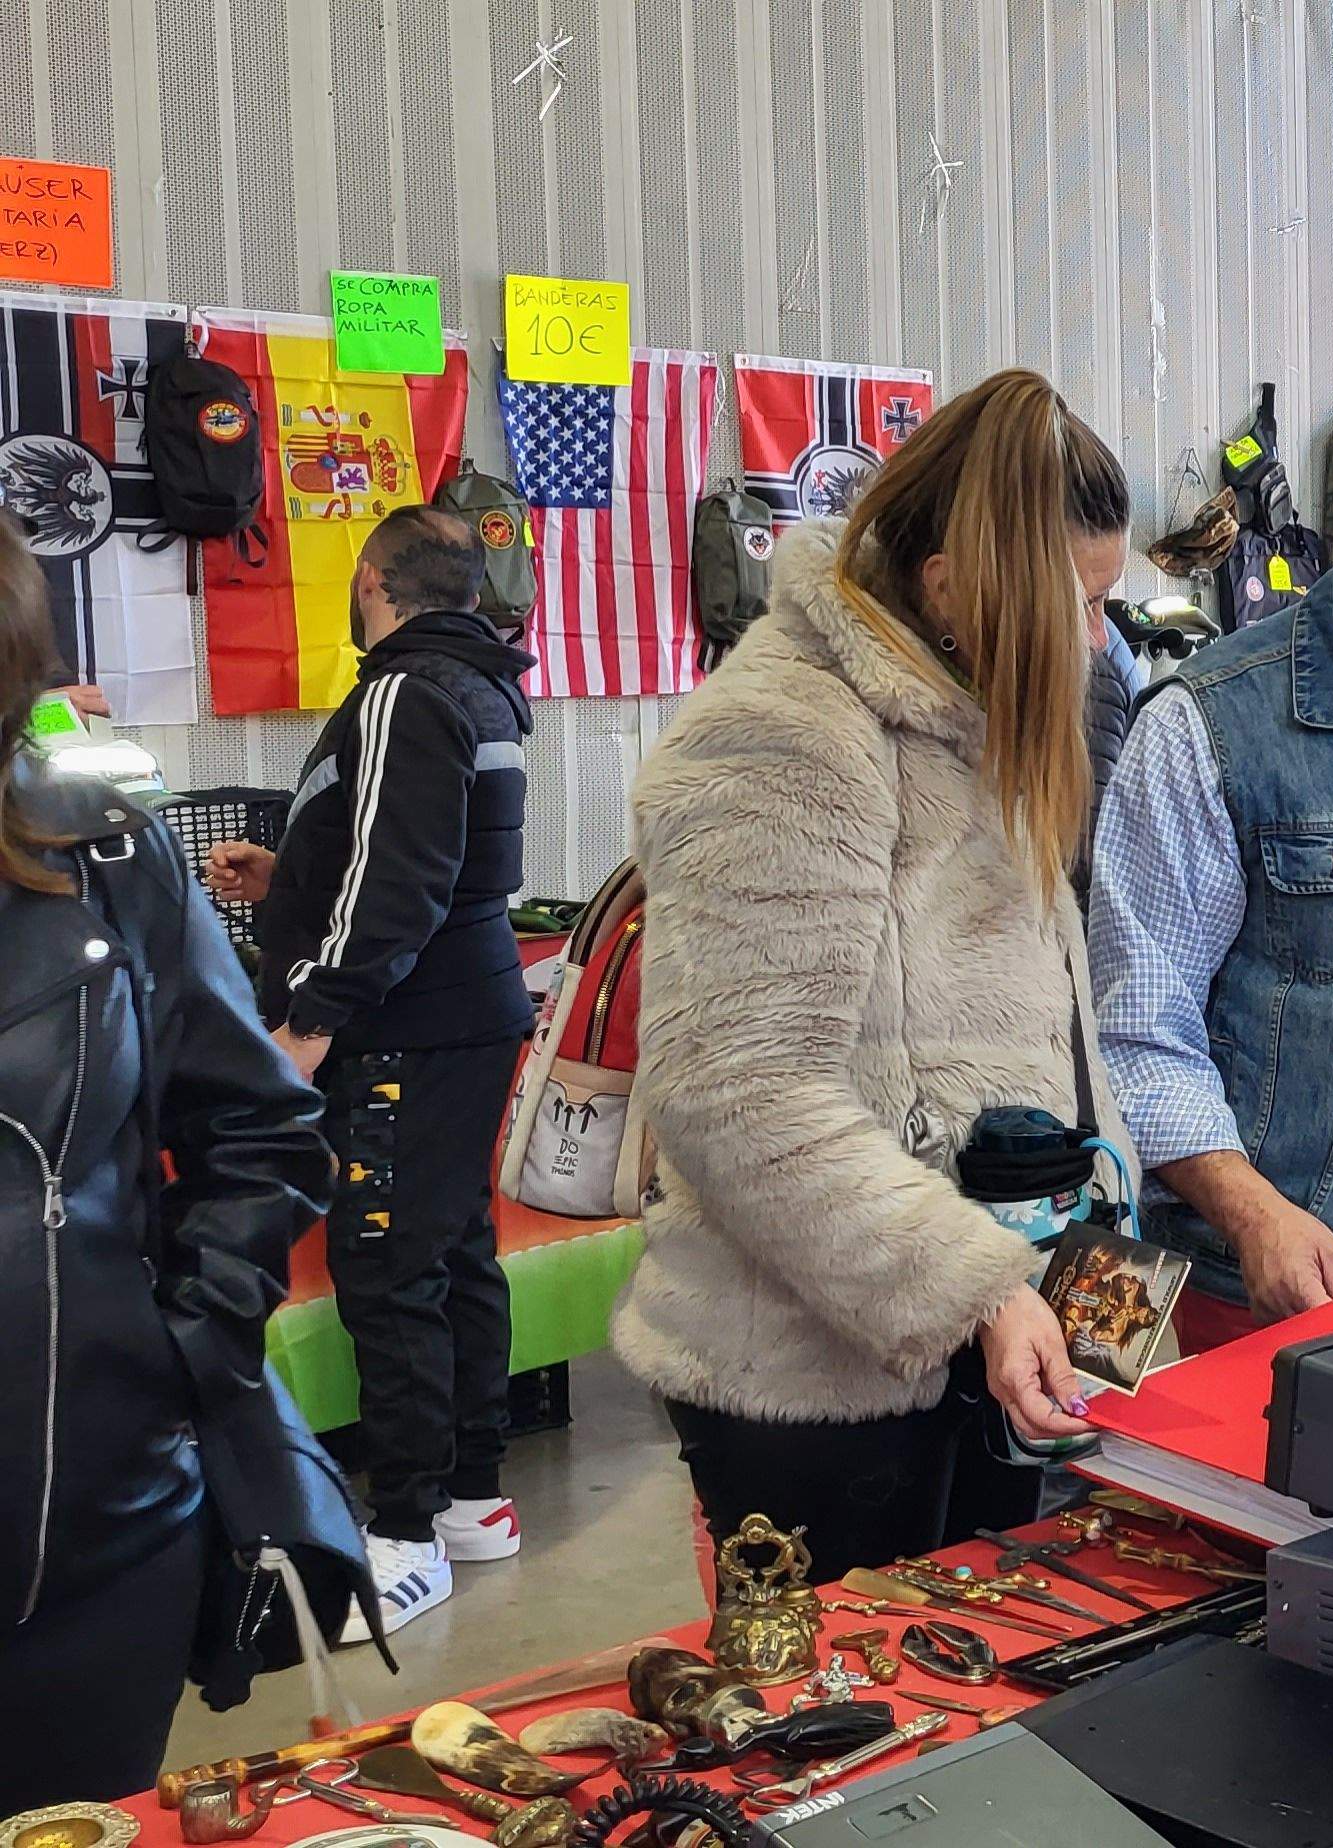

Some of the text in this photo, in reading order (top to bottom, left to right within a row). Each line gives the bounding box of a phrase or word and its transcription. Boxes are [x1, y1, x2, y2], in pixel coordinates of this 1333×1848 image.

[360, 277, 433, 296] COMPRA
[513, 283, 617, 310] BANDERAS
[337, 299, 387, 315] ROPA
[526, 313, 604, 355] 10€
[560, 1138, 579, 1154] DO
[554, 1155, 579, 1167] EPIC
[775, 1790, 845, 1825] INTEK
